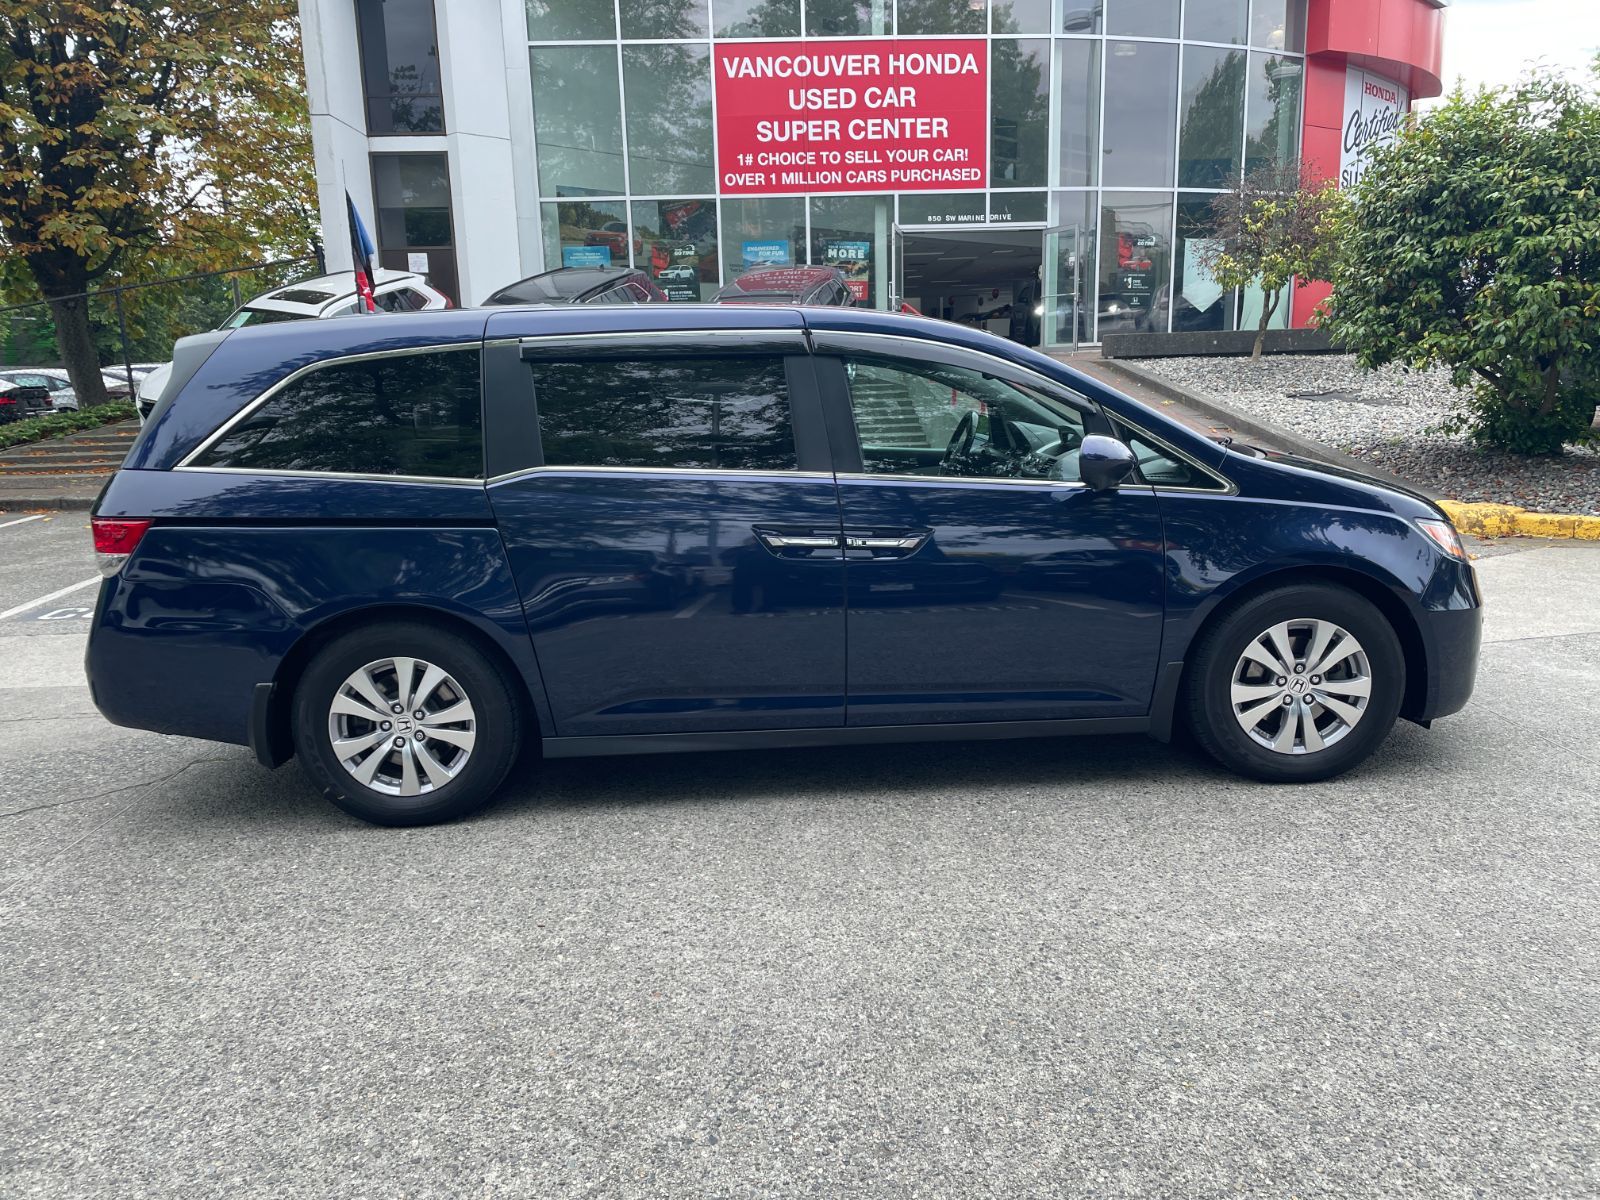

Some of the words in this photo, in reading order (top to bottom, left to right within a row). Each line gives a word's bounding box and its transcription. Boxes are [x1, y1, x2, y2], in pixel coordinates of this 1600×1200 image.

[723, 55, 880, 78] VANCOUVER
[889, 53, 978, 74] HONDA
[789, 88, 856, 110] USED
[864, 87, 915, 108] CAR
[1364, 82, 1397, 104] HONDA
[757, 120, 840, 142] SUPER
[848, 118, 948, 140] CENTER
[1344, 100, 1405, 154] Certified
[737, 154, 753, 165] 1#
[758, 152, 816, 165] CHOICE
[820, 151, 840, 164] TO
[845, 151, 882, 163] SELL
[886, 149, 928, 162] YOUR
[933, 149, 968, 161] CAR!
[725, 173, 765, 186] OVER
[770, 173, 775, 184] 1
[782, 171, 841, 184] MILLION
[846, 170, 886, 183] CARS
[891, 168, 981, 182] PURCHASED
[958, 214, 985, 222] MARINE
[989, 213, 1012, 221] DRIVE
[827, 248, 865, 259] MORE
